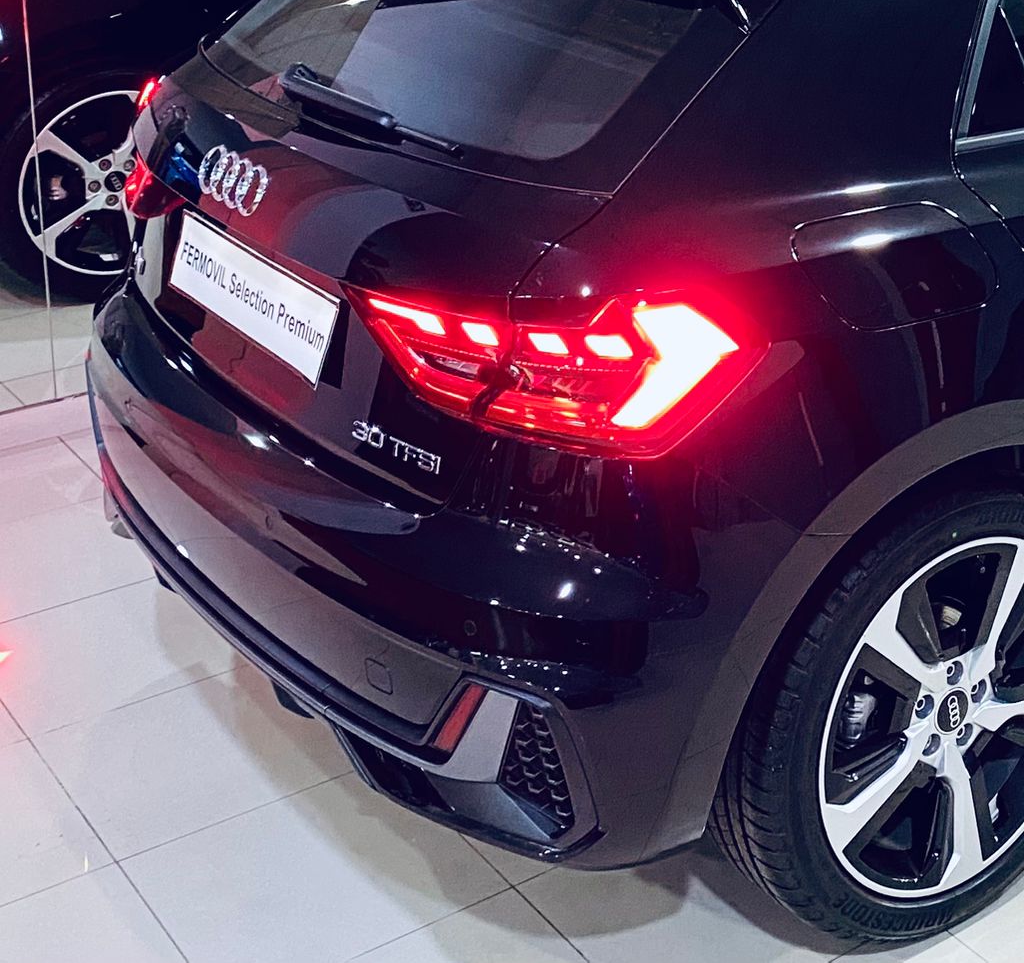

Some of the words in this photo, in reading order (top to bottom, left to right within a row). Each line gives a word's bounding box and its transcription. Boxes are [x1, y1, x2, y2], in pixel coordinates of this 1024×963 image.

[180, 241, 227, 289] FERMOVIL
[229, 272, 275, 320] Selection
[276, 302, 326, 352] Premium
[352, 420, 385, 449] 30
[389, 436, 441, 475] TFSI
